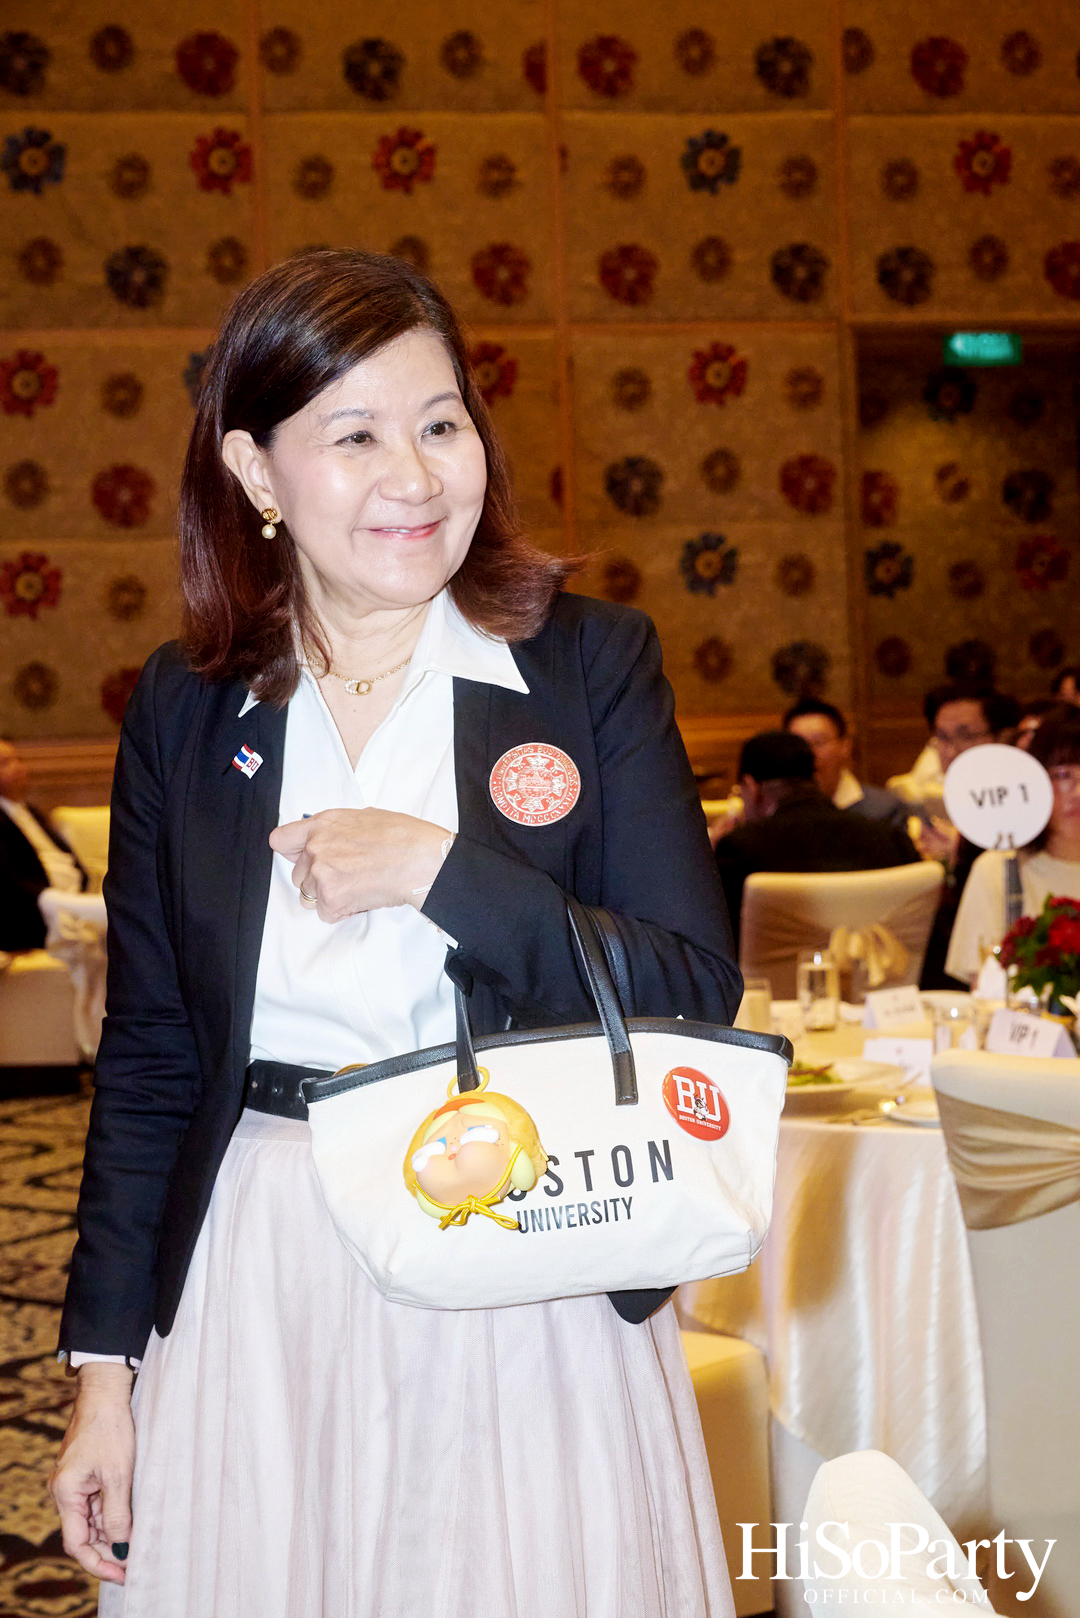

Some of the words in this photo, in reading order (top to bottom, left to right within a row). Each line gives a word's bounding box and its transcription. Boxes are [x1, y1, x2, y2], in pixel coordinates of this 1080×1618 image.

[246, 757, 260, 772] BU
[496, 745, 534, 780] UNIVERSITAS
[493, 786, 520, 820] CONDITA
[970, 786, 1008, 807] VIP
[1019, 783, 1028, 804] 1
[1009, 1022, 1030, 1044] VIP
[672, 1074, 722, 1122] BU
[508, 1139, 674, 1201] STON
[516, 1196, 633, 1234] UNIVERSITY
